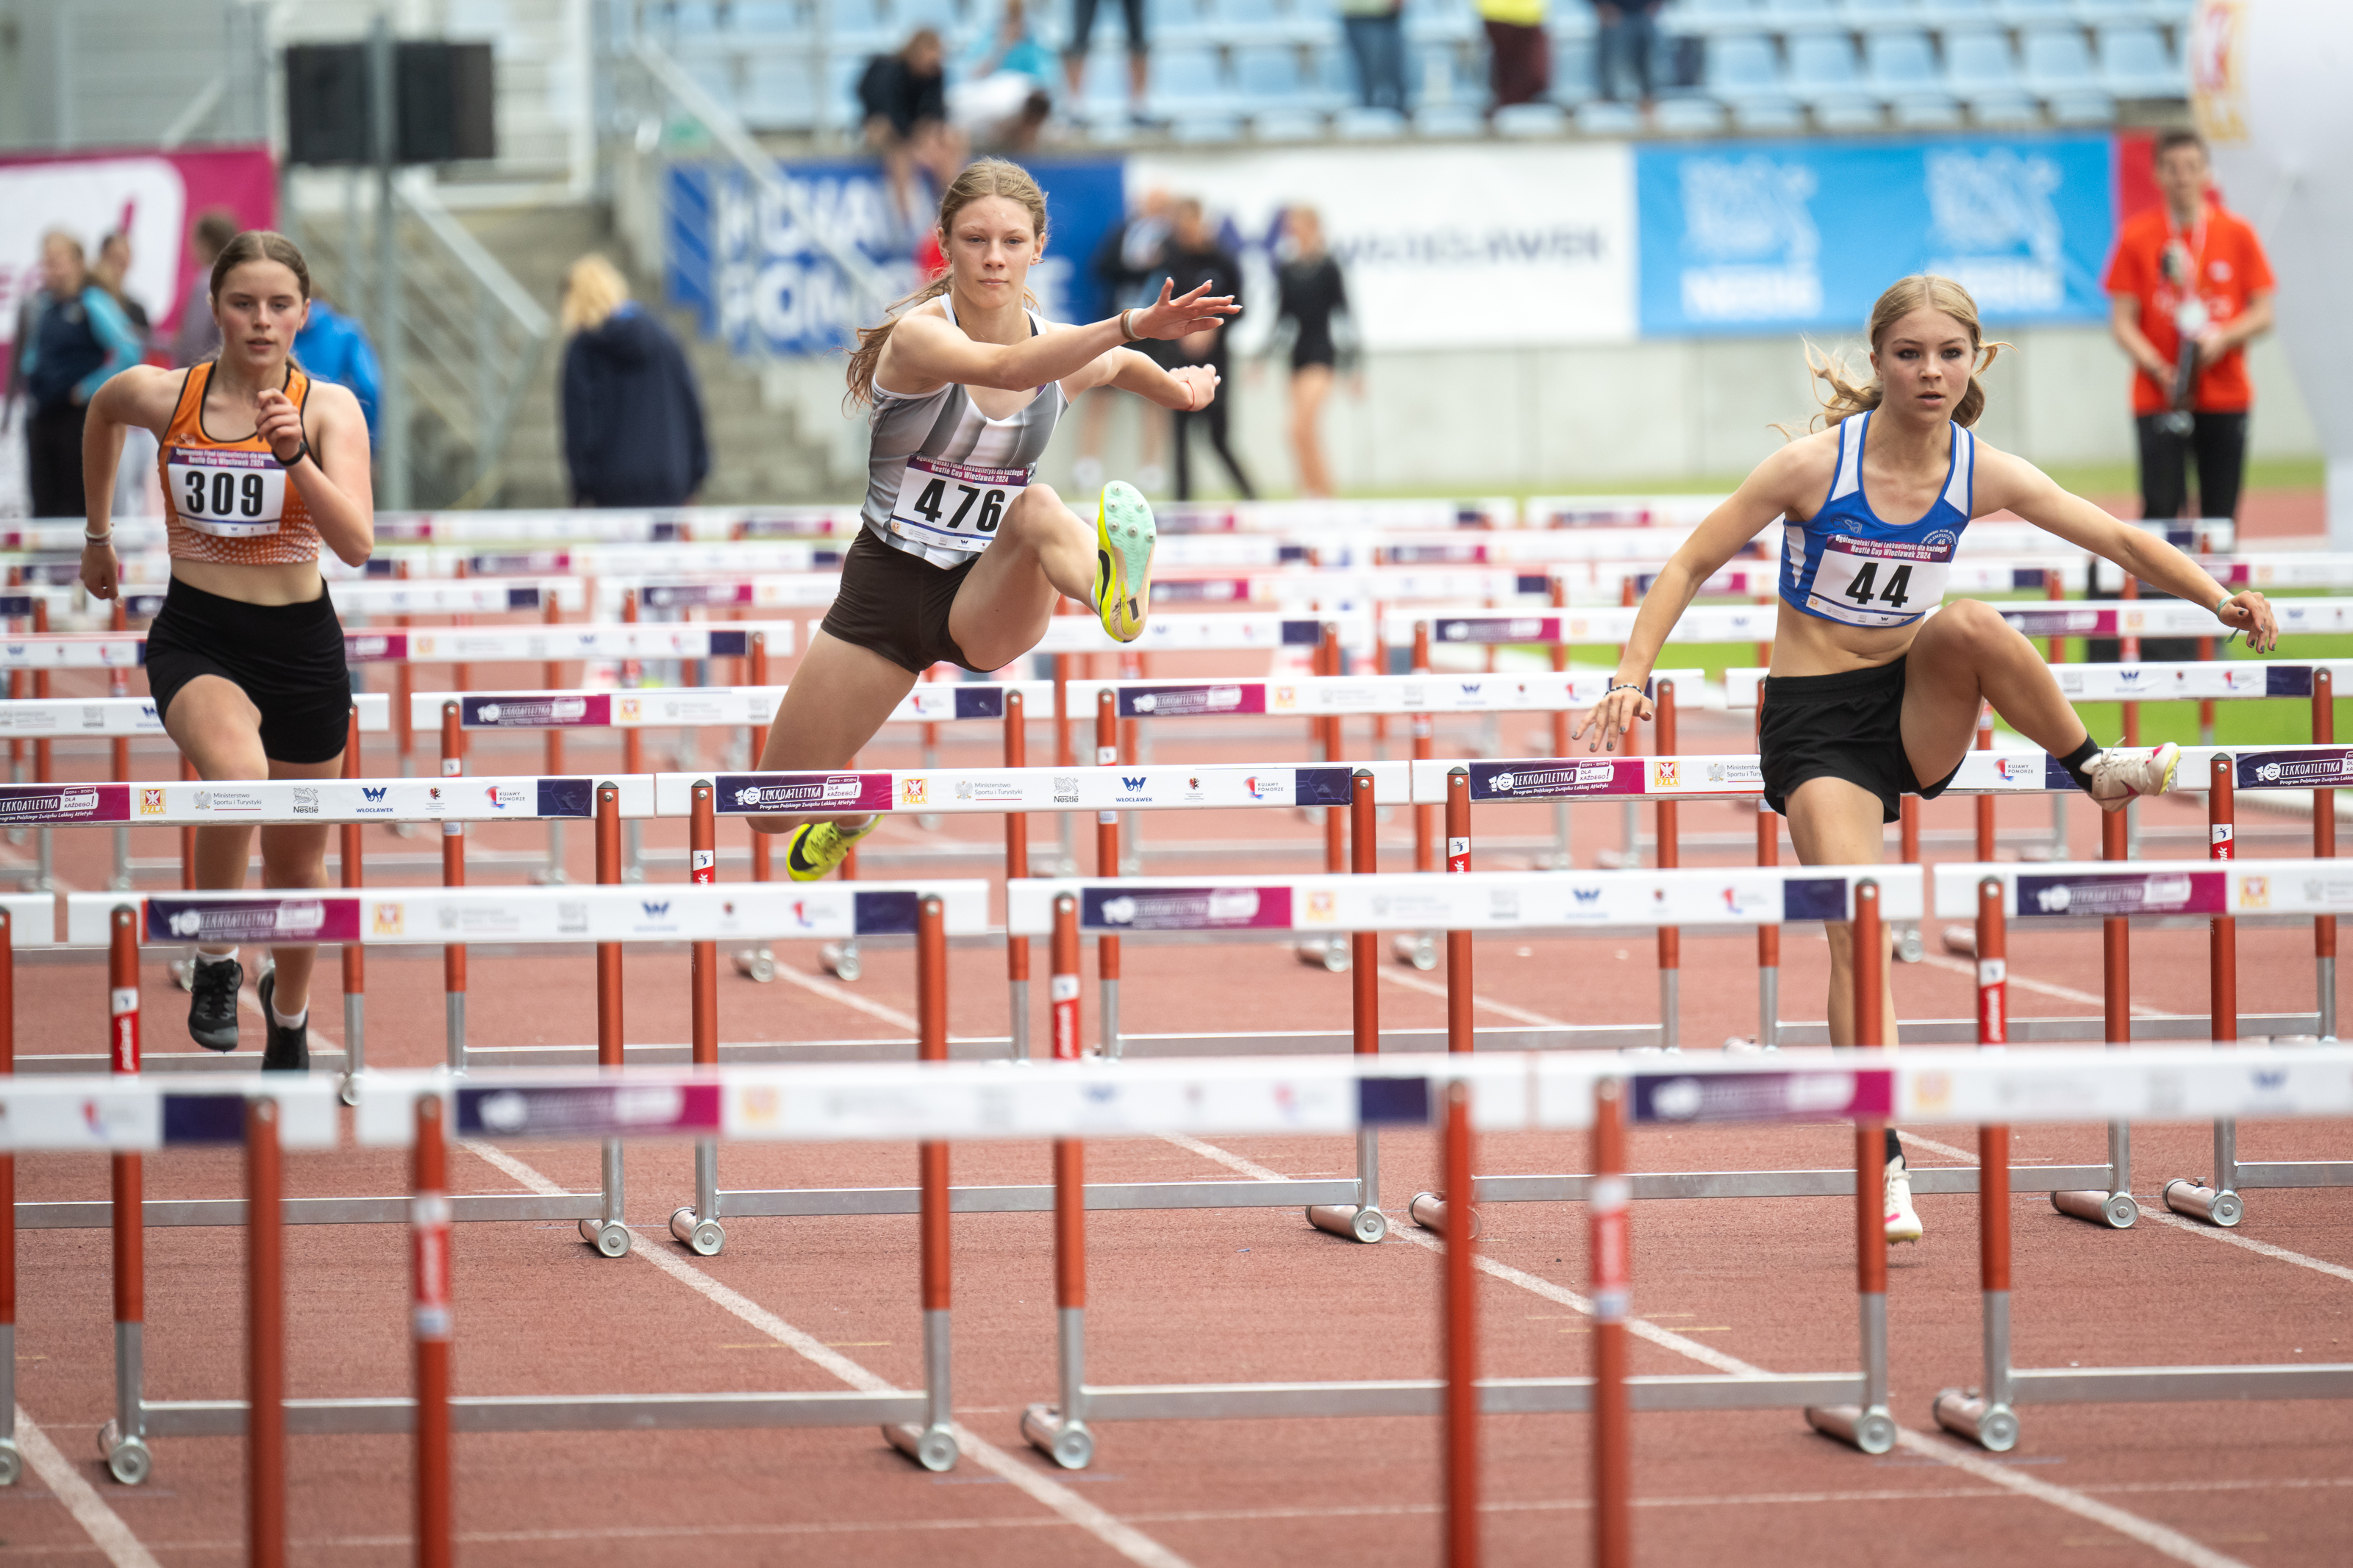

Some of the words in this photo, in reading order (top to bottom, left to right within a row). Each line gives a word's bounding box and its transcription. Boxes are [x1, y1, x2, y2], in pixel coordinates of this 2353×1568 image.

[931, 464, 951, 475] Nestlé
[951, 470, 963, 479] Cup
[996, 475, 1009, 483] 2024
[185, 470, 263, 517] 309
[914, 478, 1005, 532] 476
[1835, 534, 1870, 547] Ogólnopolski
[1851, 545, 1871, 555] Nestlé
[1871, 548, 1882, 556] Cup
[1883, 548, 1915, 559] Włocławek
[1916, 551, 1932, 559] 2024
[1845, 562, 1913, 608] 44
[2281, 762, 2340, 776] LEKKOATLETYKA
[1515, 771, 1574, 786] LEKKOATLETYKA
